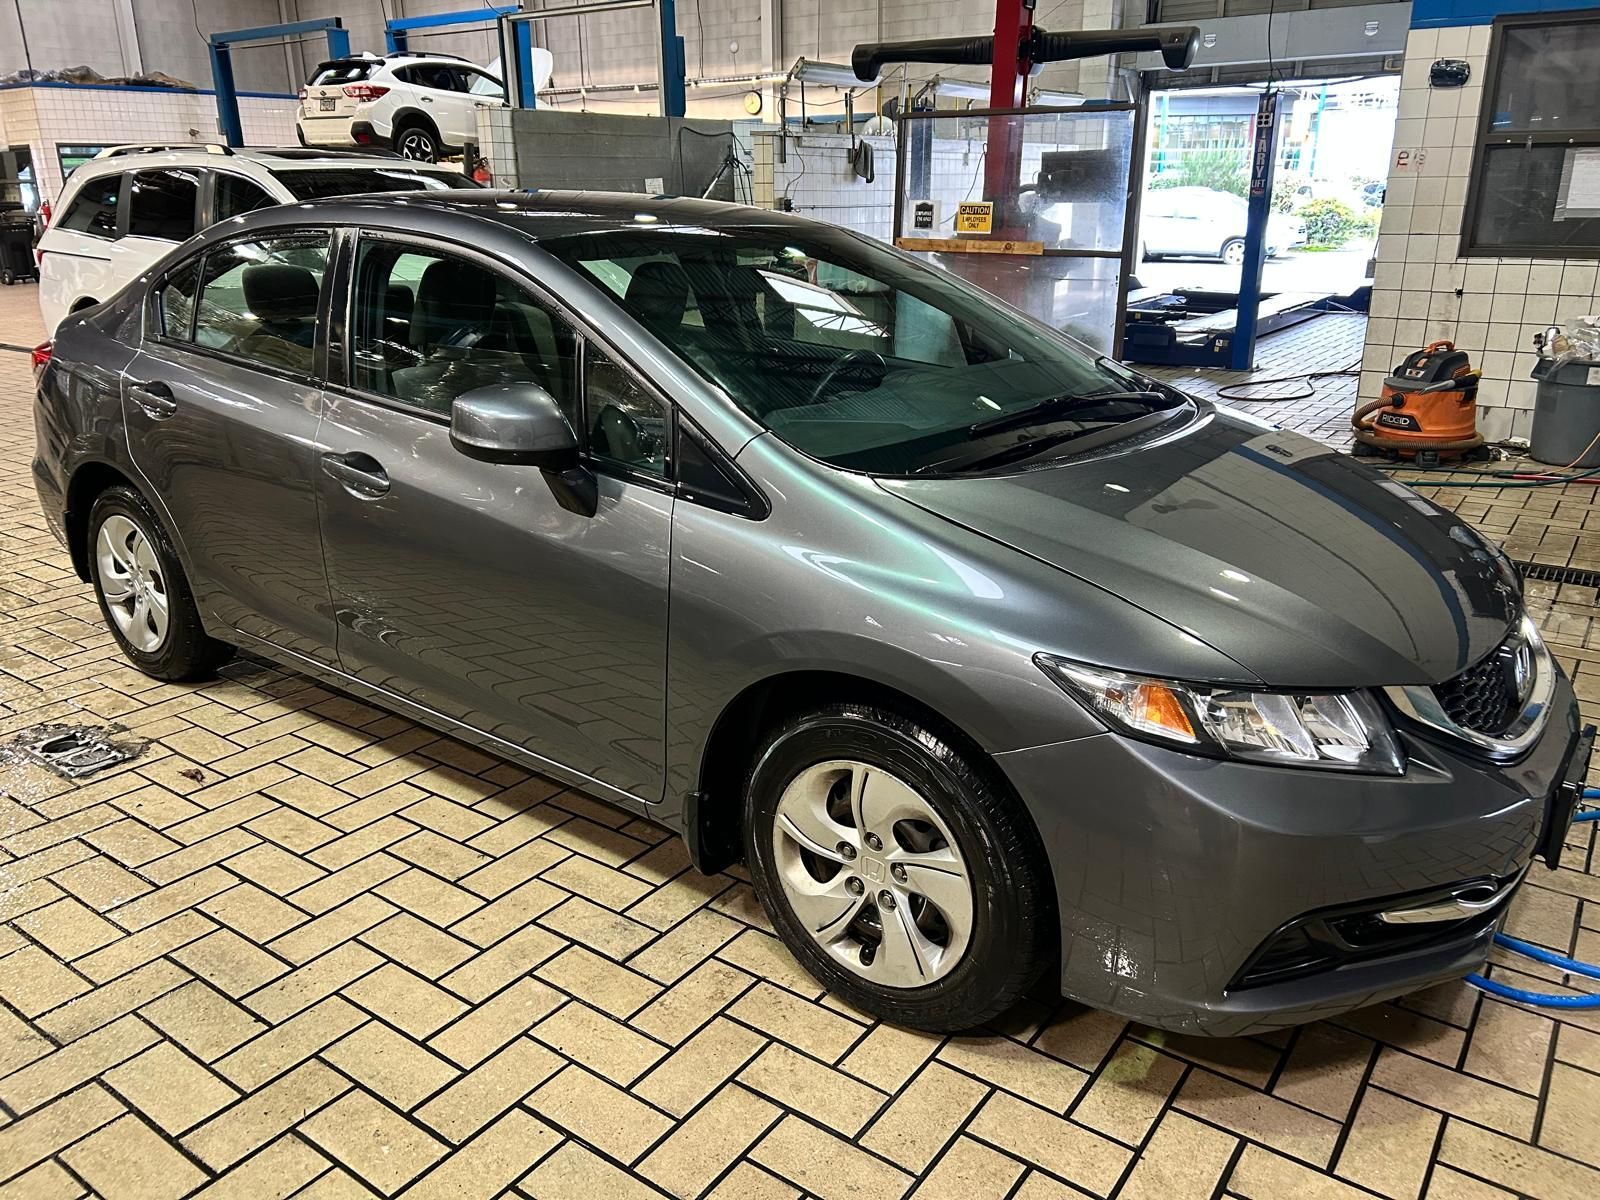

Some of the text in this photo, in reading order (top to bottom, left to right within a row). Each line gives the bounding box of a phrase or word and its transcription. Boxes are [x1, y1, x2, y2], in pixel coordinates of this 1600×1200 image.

[1251, 179, 1265, 188] LIFT
[960, 206, 990, 214] CAUTION
[1382, 414, 1410, 424] RIDGID
